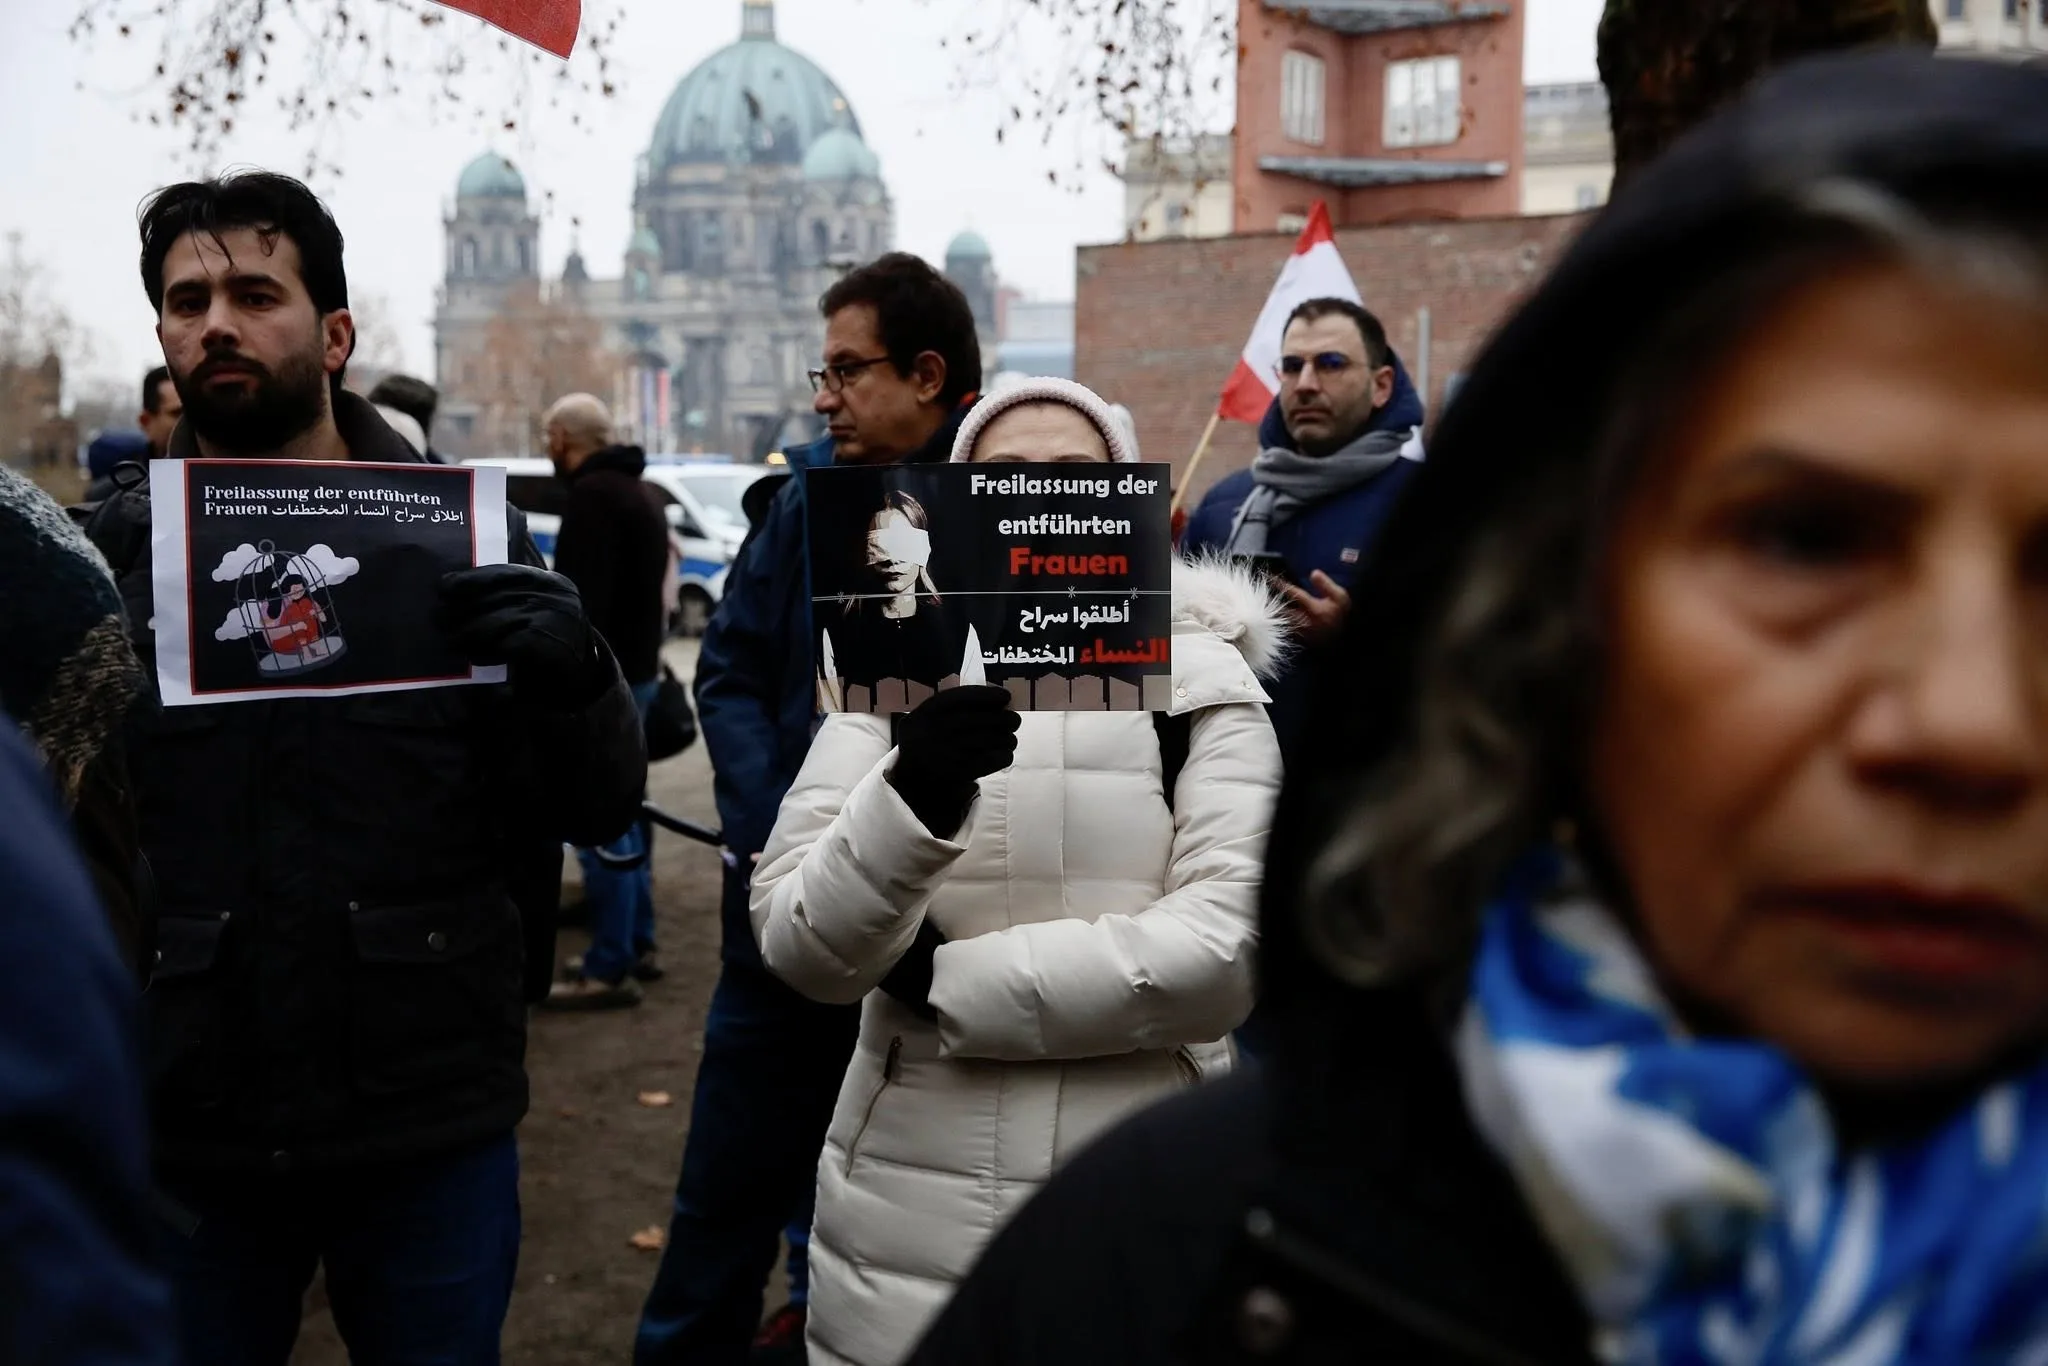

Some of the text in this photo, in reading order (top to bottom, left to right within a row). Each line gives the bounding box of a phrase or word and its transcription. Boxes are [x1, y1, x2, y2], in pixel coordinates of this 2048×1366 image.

[204, 485, 441, 505] Freilassung der entführten
[970, 474, 1158, 498] Freilassung der
[205, 502, 268, 515] Frauen
[271, 503, 464, 525] إطلاق سراح النساء المختطفات
[998, 513, 1131, 535] entführten
[1009, 547, 1128, 575] Frauen
[1019, 600, 1130, 633] أطلقوا سراح
[981, 638, 1169, 665] النساء المختطفات
